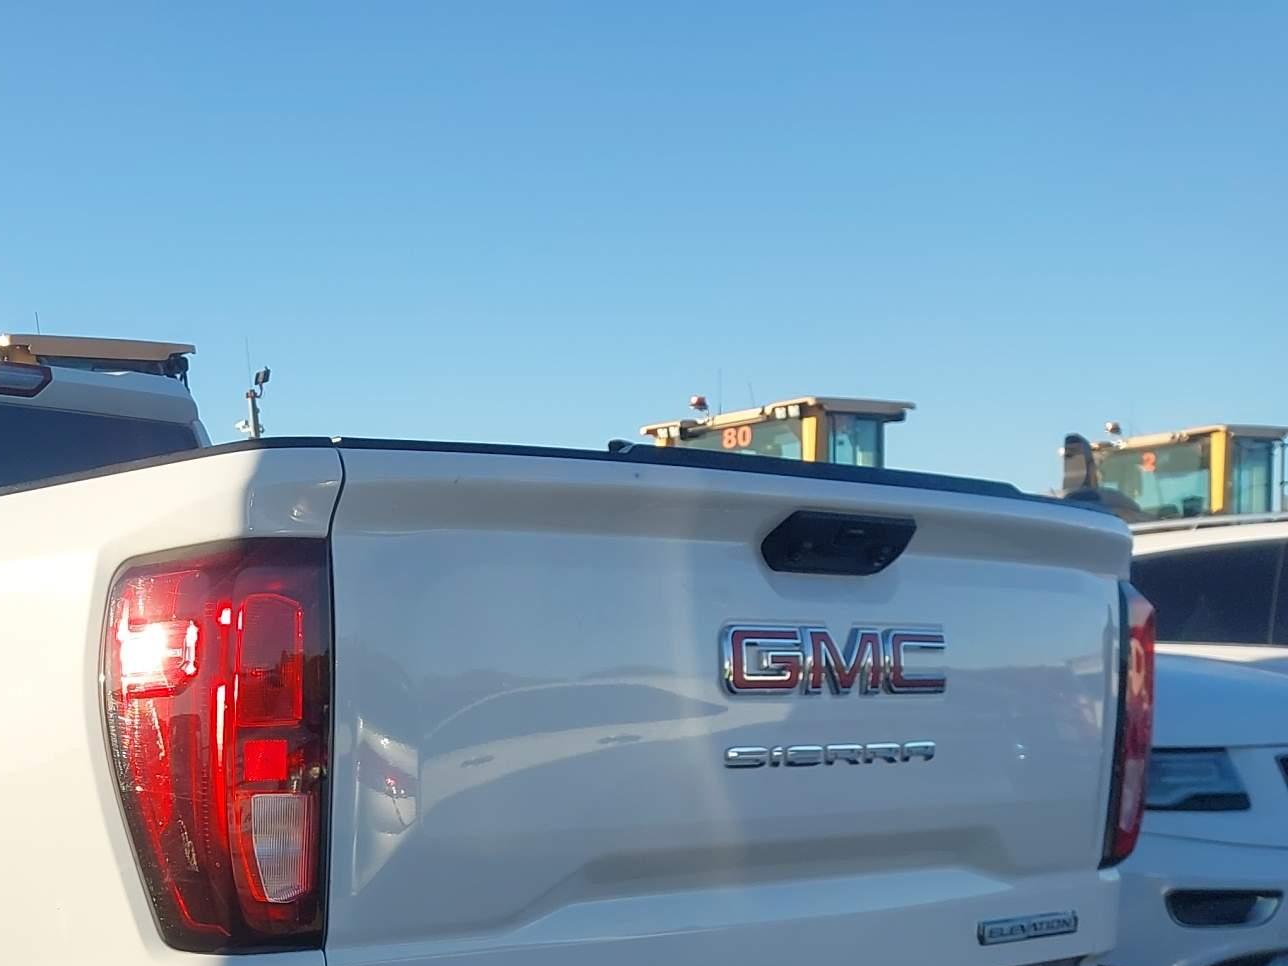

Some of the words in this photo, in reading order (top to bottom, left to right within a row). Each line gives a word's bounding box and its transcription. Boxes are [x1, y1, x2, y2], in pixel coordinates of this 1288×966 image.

[722, 425, 752, 449] 80
[720, 624, 947, 696] GMC
[723, 740, 936, 769] SIERRA
[988, 917, 1073, 938] ELEVATION
